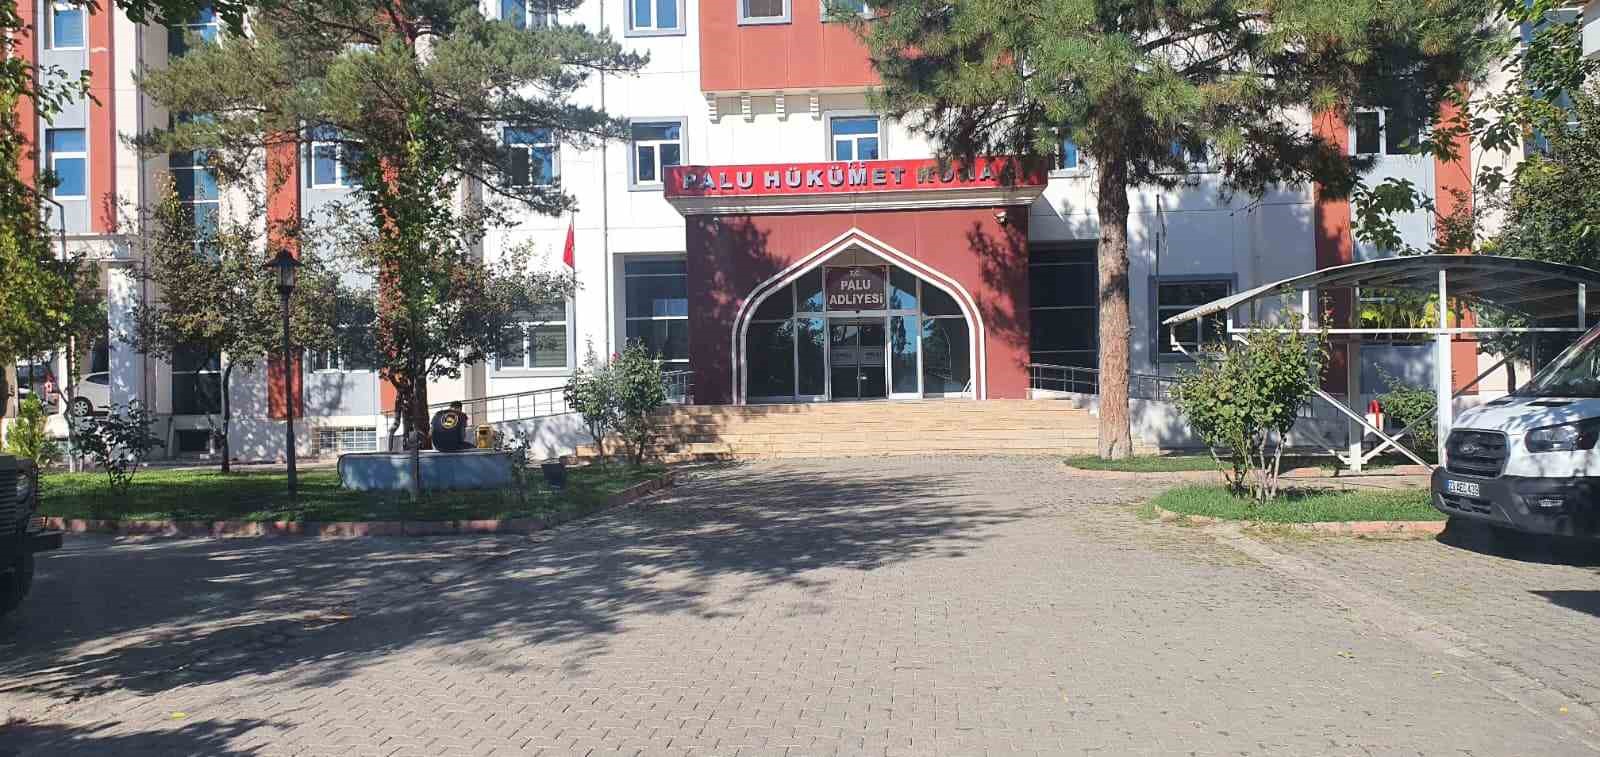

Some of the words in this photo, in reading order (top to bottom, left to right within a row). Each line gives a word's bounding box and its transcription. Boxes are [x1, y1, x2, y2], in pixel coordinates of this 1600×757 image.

[682, 171, 753, 190] PALU
[765, 166, 906, 189] HÜKÜMET
[840, 279, 871, 290] PALU
[829, 293, 883, 304] ADLİYESİ
